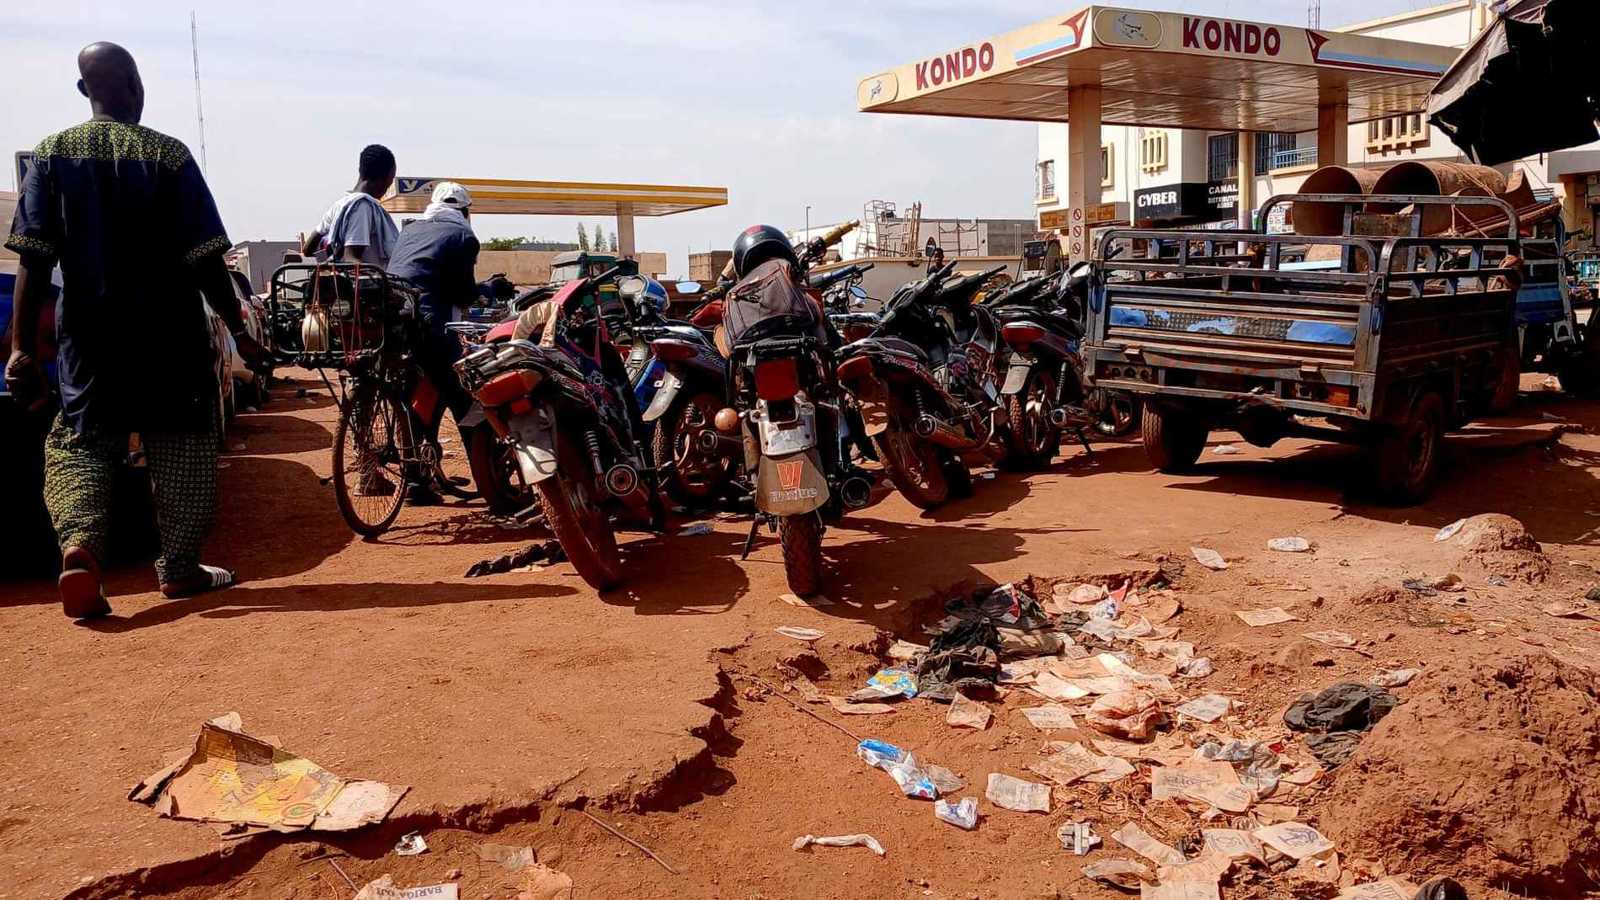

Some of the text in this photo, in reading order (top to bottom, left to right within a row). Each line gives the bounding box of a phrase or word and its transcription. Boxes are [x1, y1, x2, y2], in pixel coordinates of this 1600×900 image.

[1182, 16, 1281, 56] KONDO
[915, 42, 995, 90] KONDO
[1138, 192, 1177, 208] CYBER
[1209, 185, 1238, 195] CANAL
